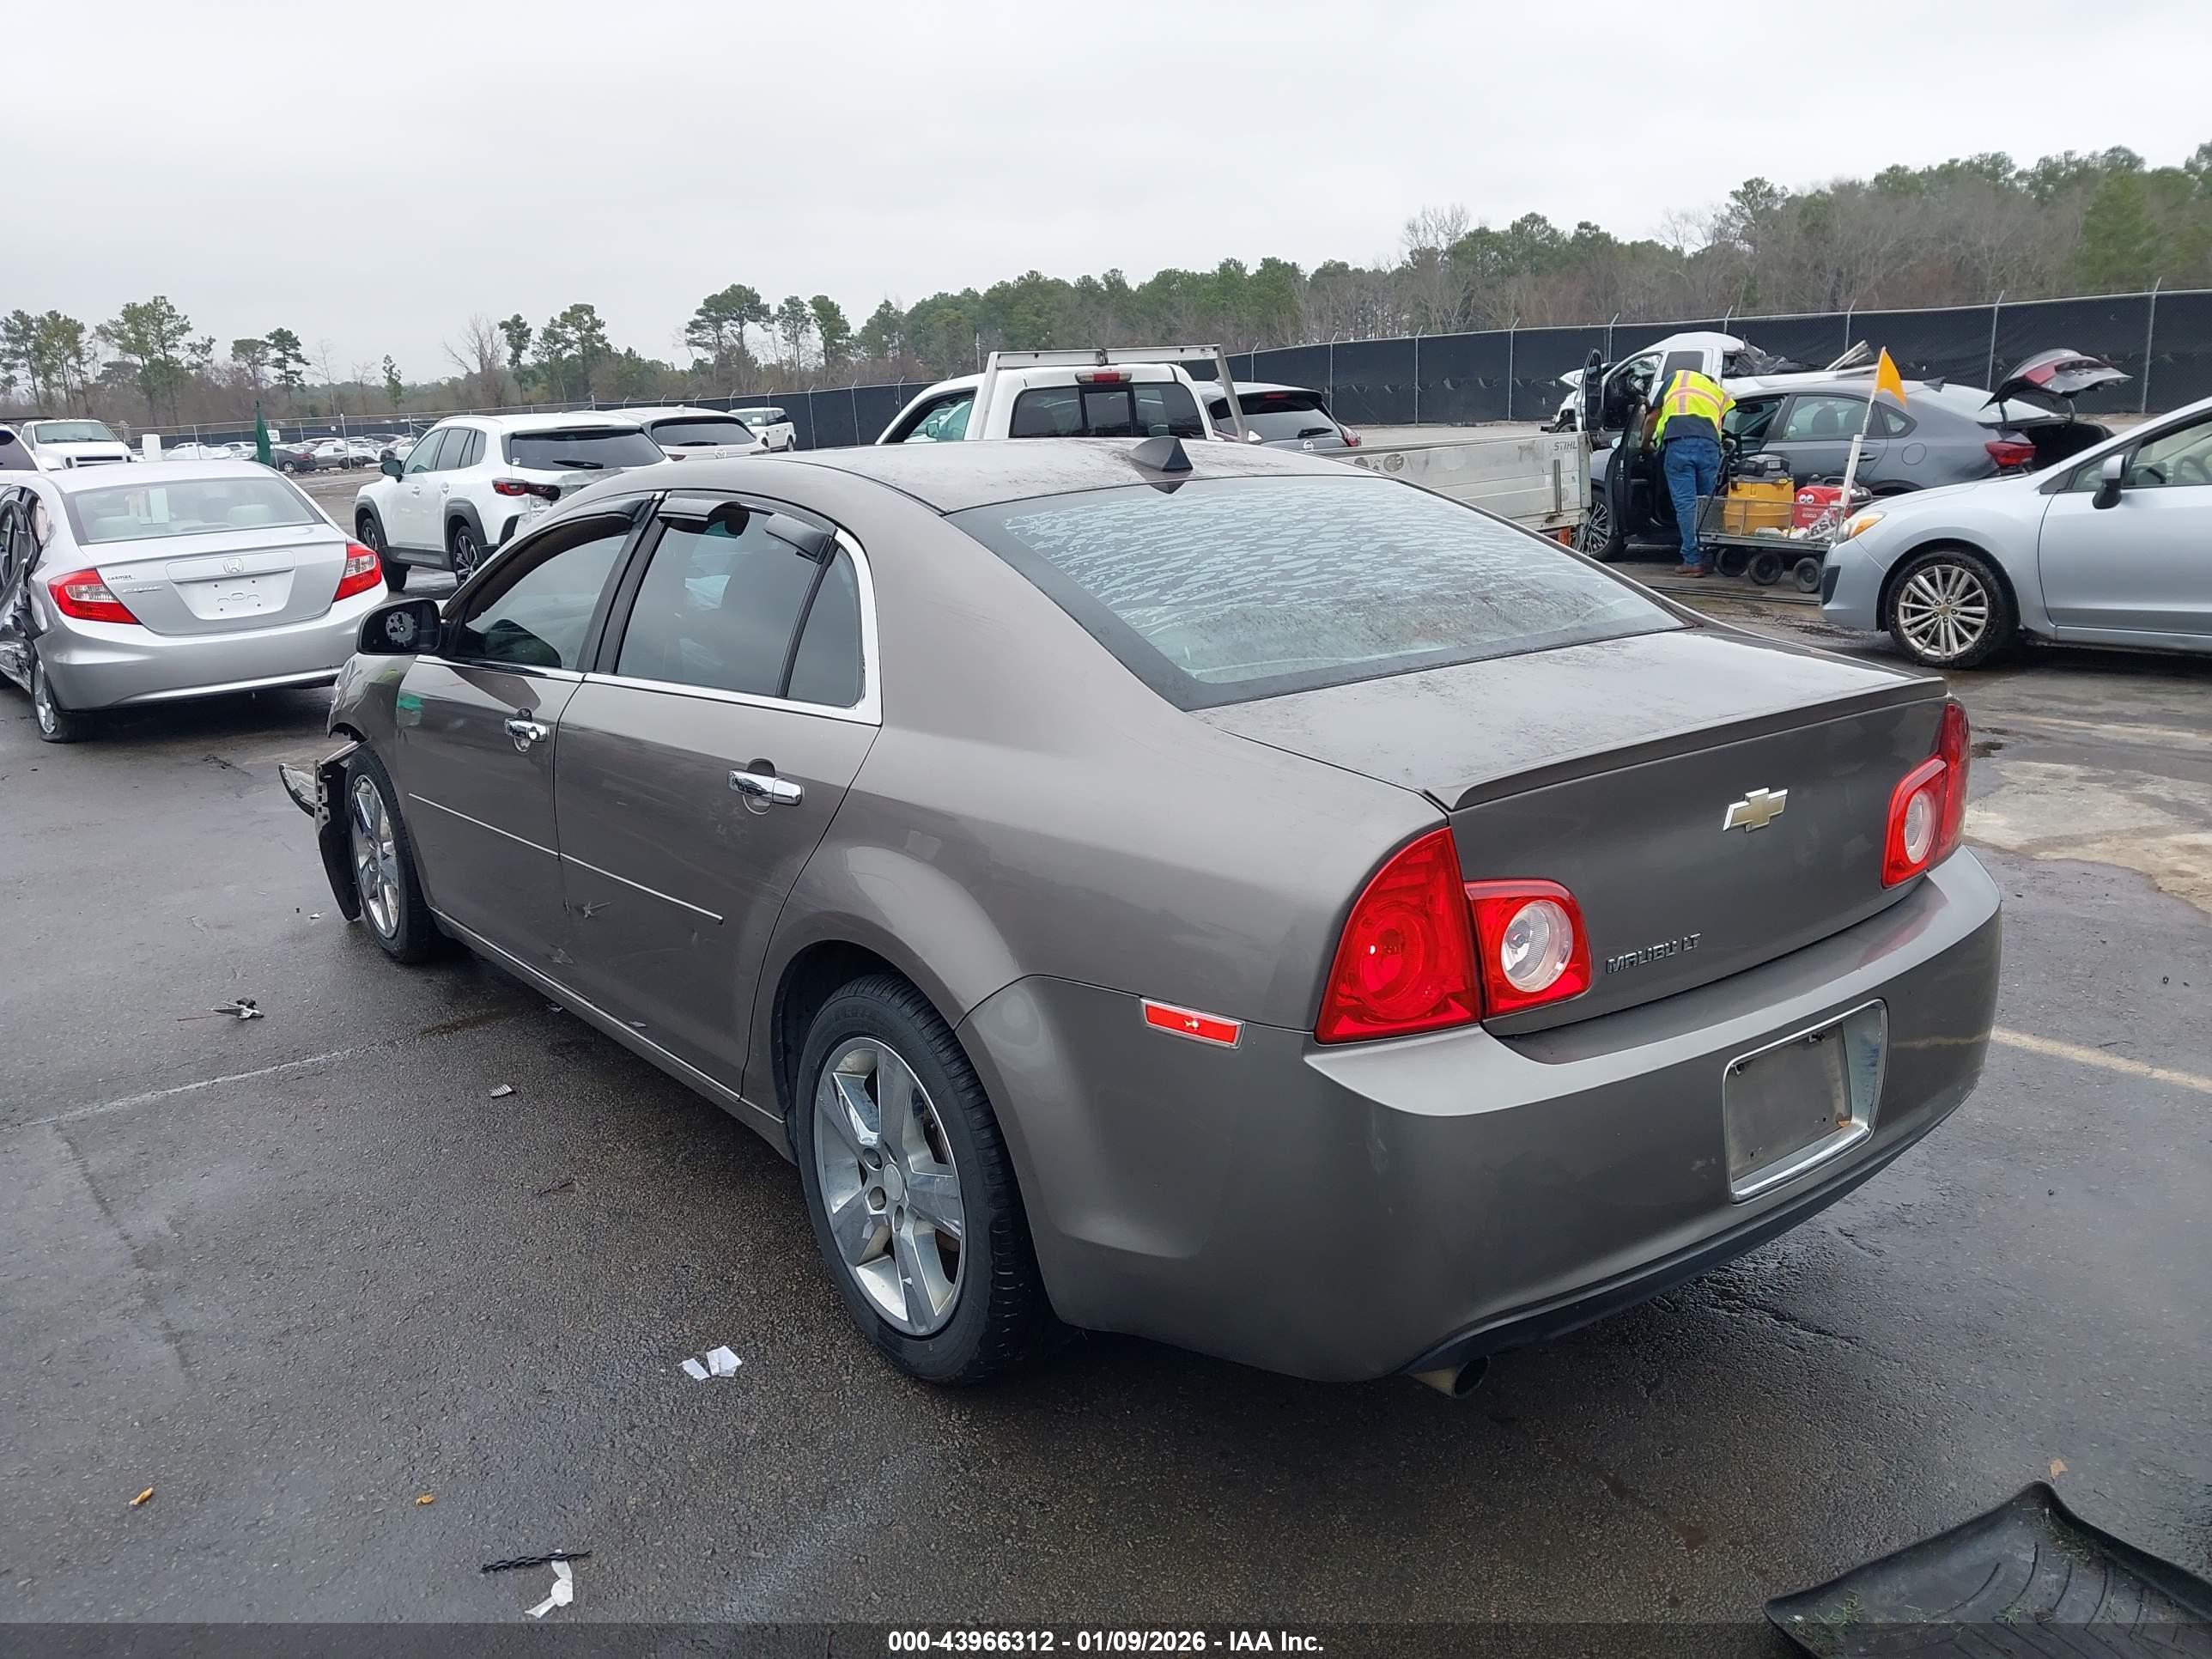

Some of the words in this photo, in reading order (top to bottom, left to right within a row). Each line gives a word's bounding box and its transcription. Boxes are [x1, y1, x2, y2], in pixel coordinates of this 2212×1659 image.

[1553, 440, 1577, 452] STIHL
[1606, 940, 1677, 974] MALIBU
[1681, 933, 1701, 951] LT
